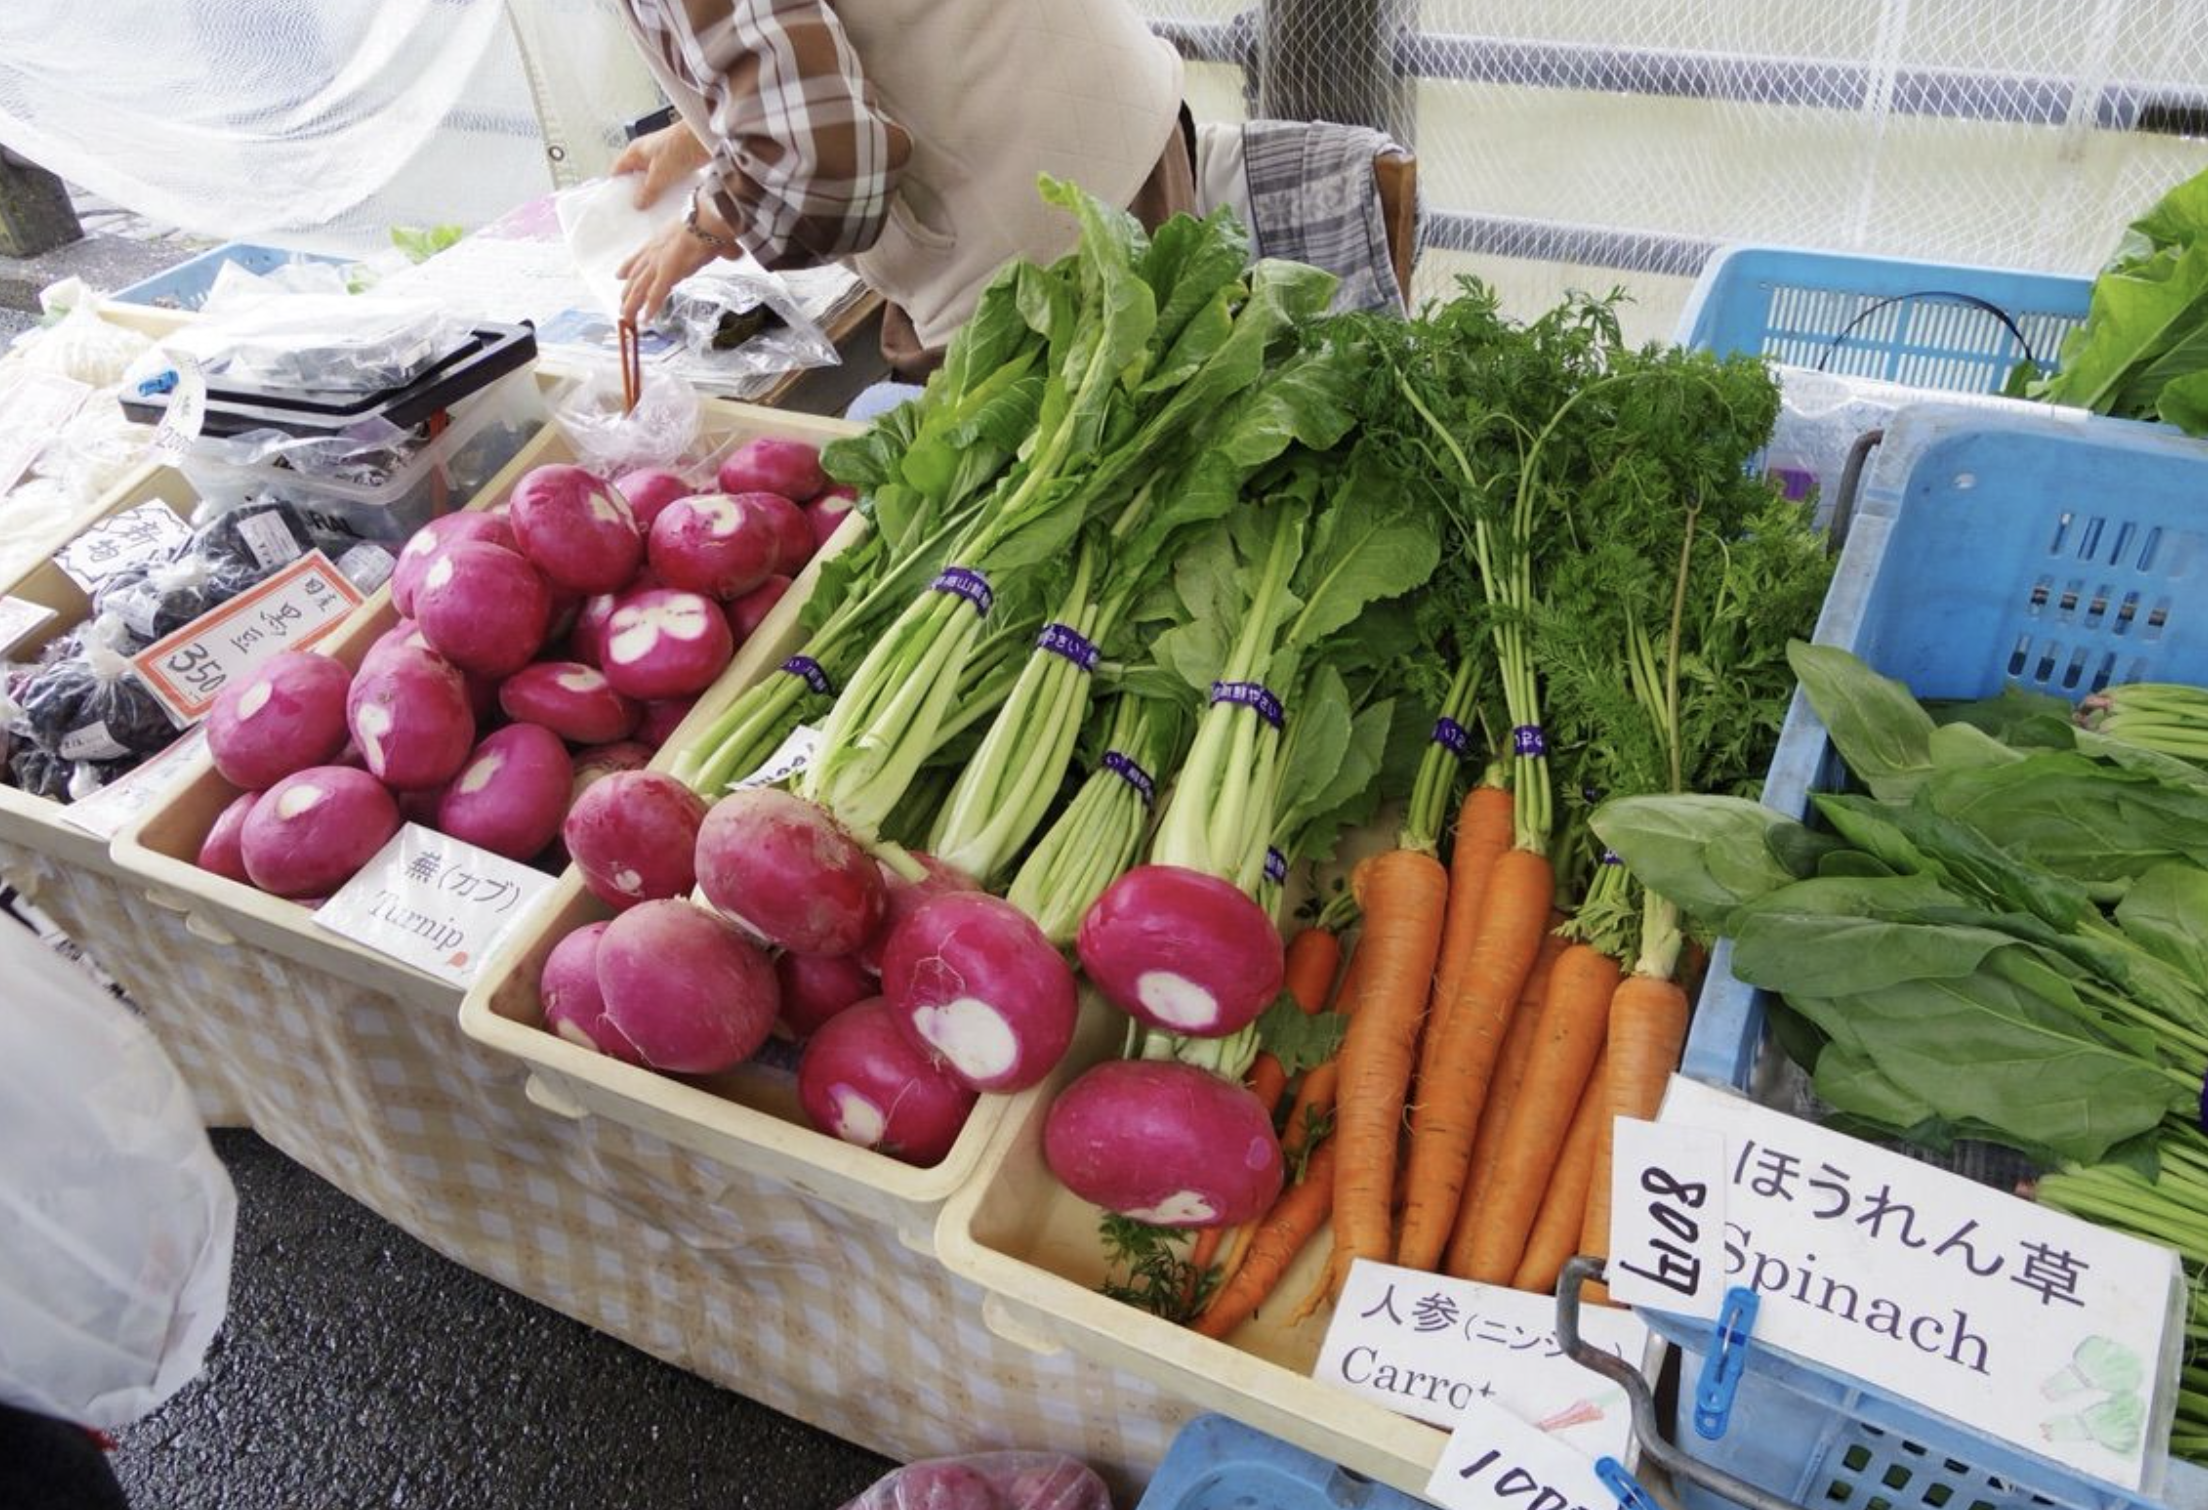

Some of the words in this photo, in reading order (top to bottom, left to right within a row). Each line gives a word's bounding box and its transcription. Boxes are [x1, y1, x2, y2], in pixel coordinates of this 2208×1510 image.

[166, 642, 227, 694] 350
[368, 888, 465, 951] Turnip
[1619, 1165, 1707, 1296] 80円
[1733, 1139, 2091, 1309] ほうれん草
[1723, 1220, 1991, 1376] Spinach
